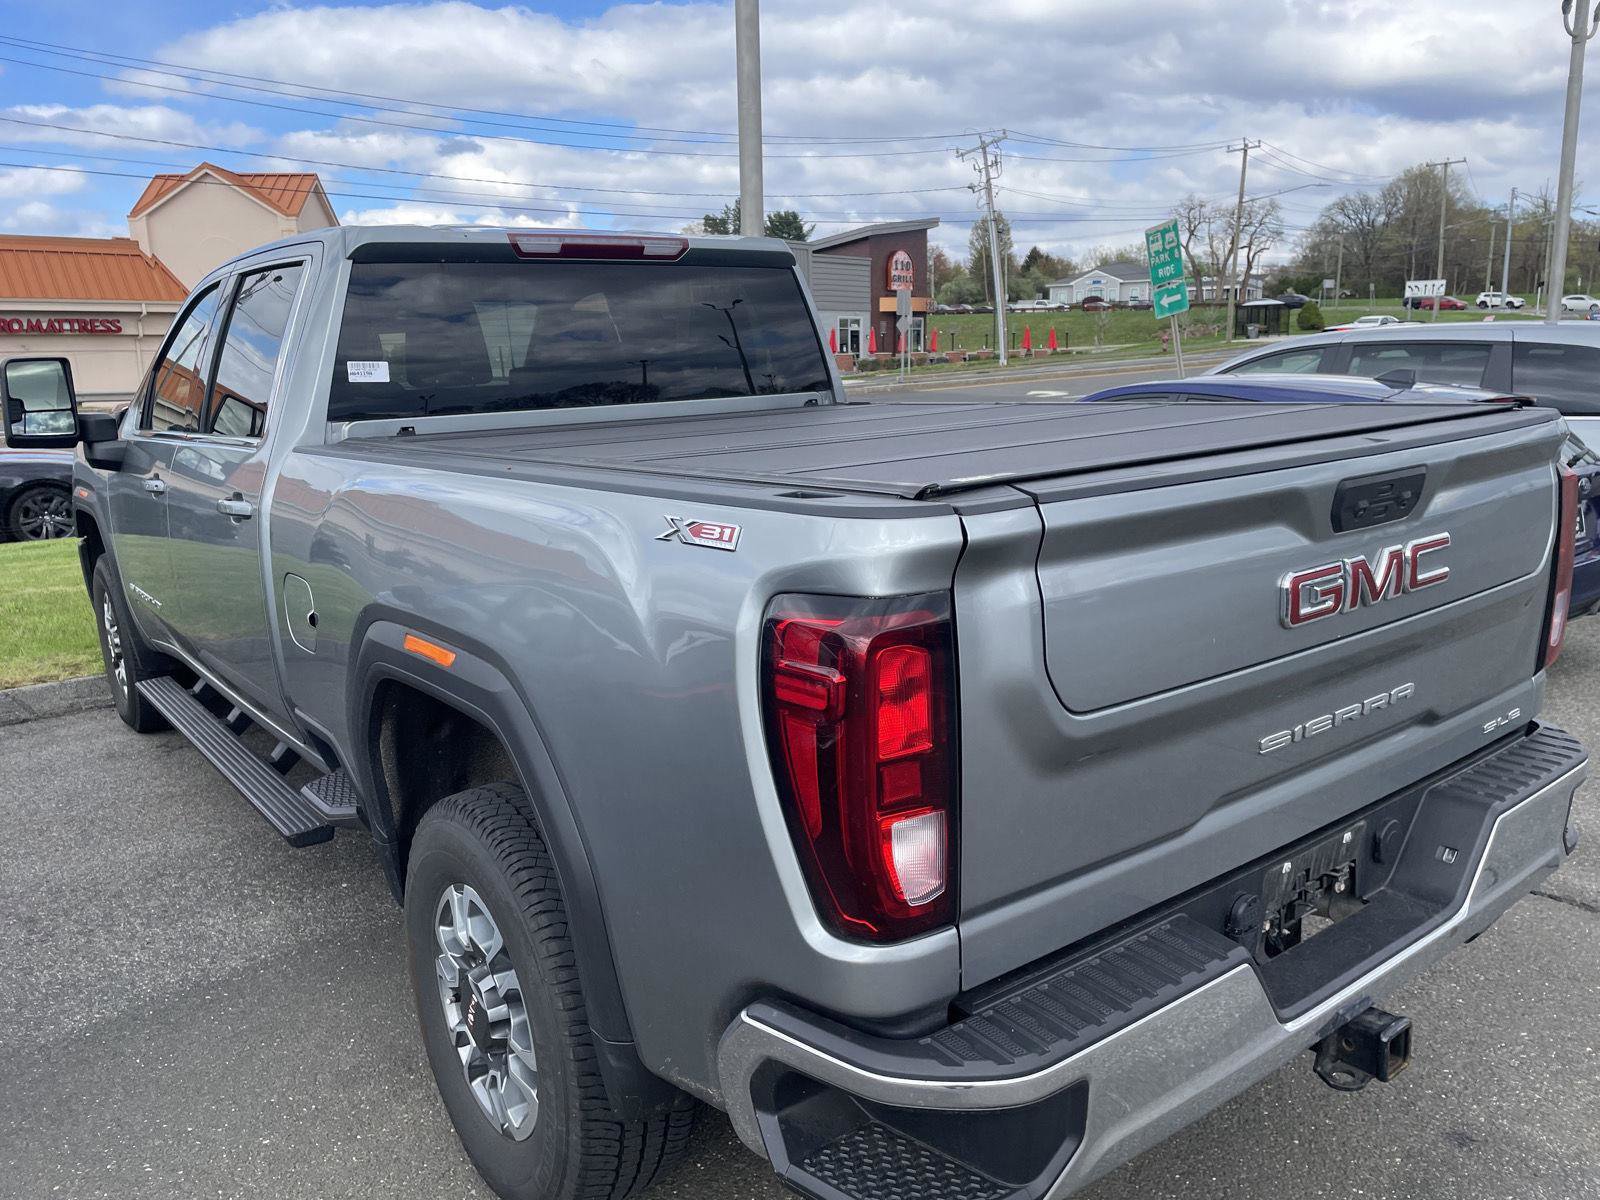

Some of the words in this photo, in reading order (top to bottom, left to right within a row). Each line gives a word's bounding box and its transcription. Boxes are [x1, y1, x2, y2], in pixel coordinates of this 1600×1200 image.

[894, 260, 911, 271] 110
[1150, 251, 1171, 267] PARK
[892, 275, 913, 283] GRILL
[1158, 264, 1176, 278] RIDE
[26, 318, 122, 334] MATTRESS
[1279, 532, 1451, 629] GMC
[1259, 682, 1415, 754] SIERRA
[1482, 707, 1521, 735] SLE
